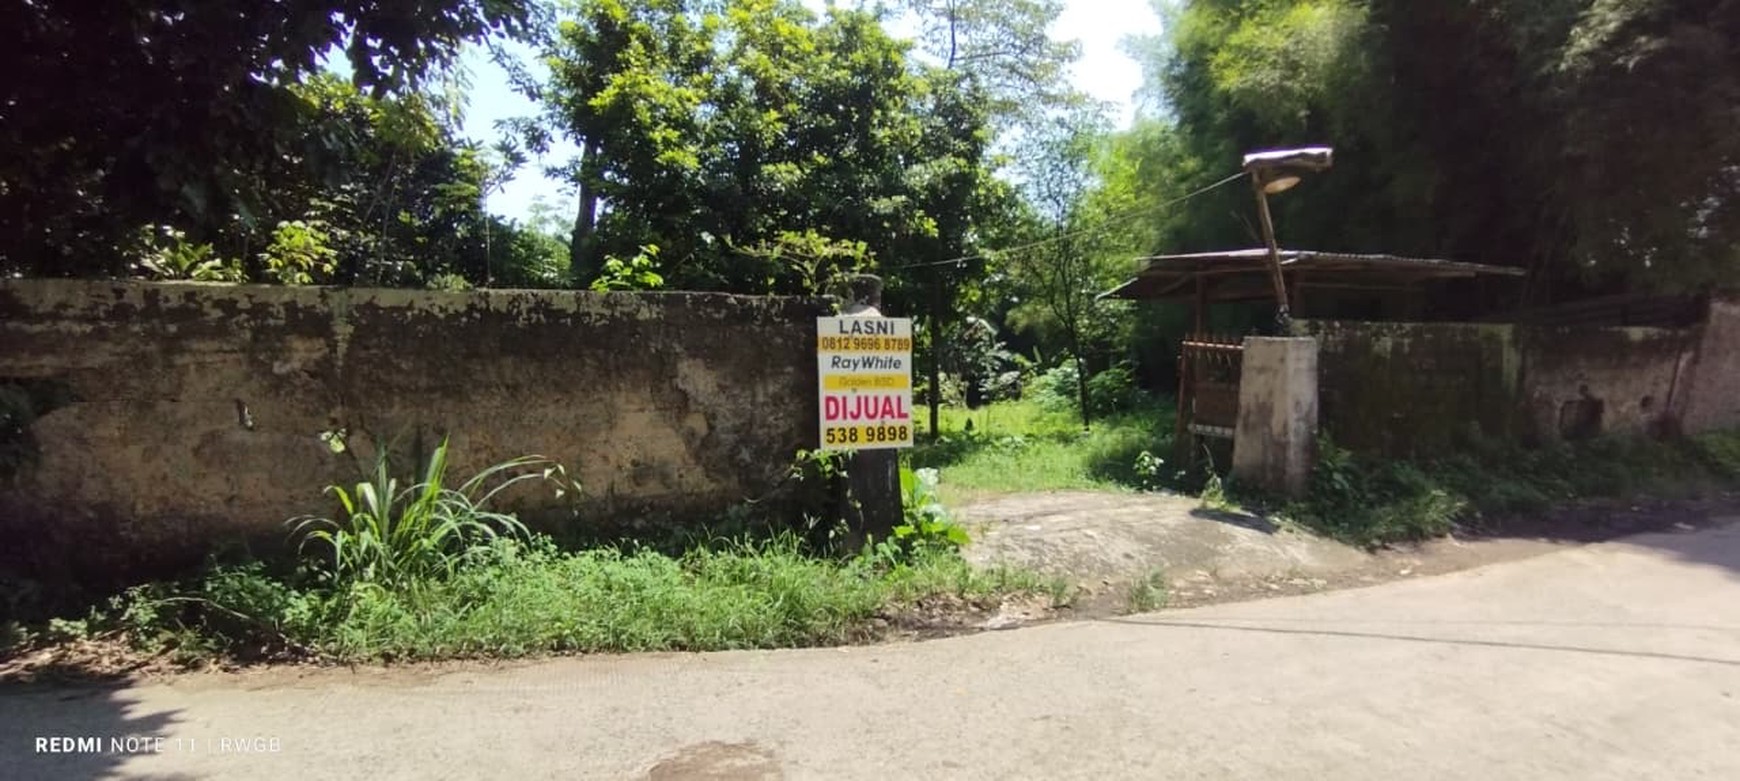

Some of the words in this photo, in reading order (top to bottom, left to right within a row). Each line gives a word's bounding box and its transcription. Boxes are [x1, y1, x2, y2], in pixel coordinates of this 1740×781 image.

[839, 320, 895, 335] LASNI
[825, 395, 909, 421] DIJUAL
[826, 427, 858, 444] 538
[866, 425, 908, 442] 9898
